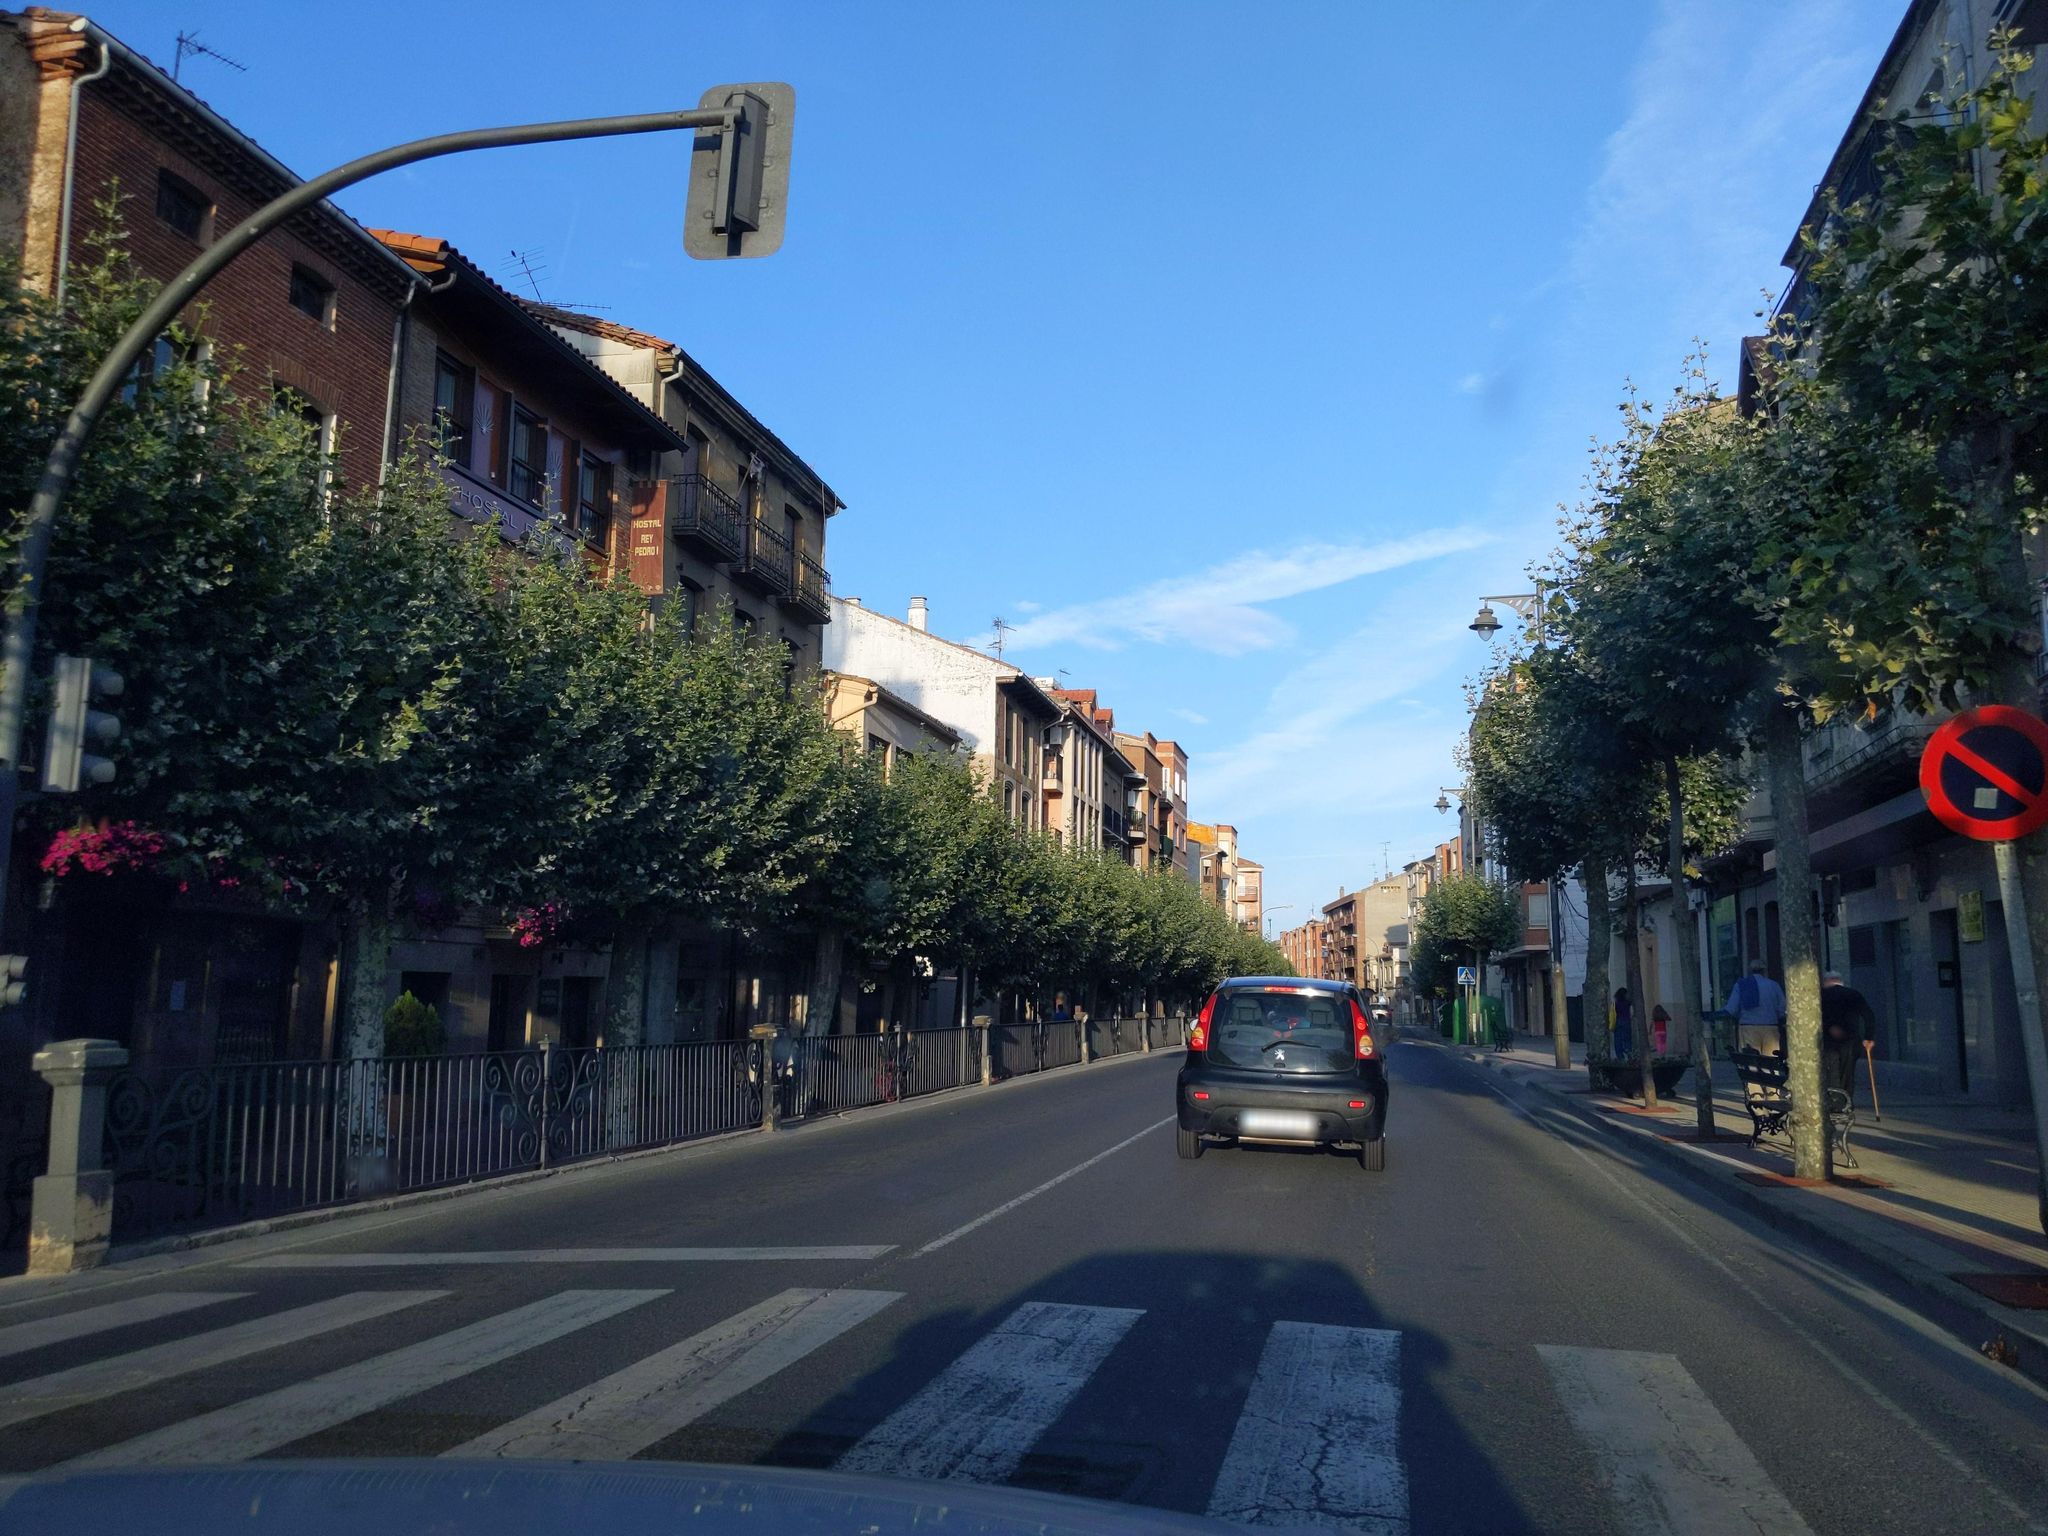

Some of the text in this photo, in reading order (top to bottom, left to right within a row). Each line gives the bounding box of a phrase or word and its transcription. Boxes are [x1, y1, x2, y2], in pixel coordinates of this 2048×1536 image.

[633, 519, 662, 529] HOSTAL
[640, 534, 654, 544] REY
[634, 546, 656, 556] PEDRO
